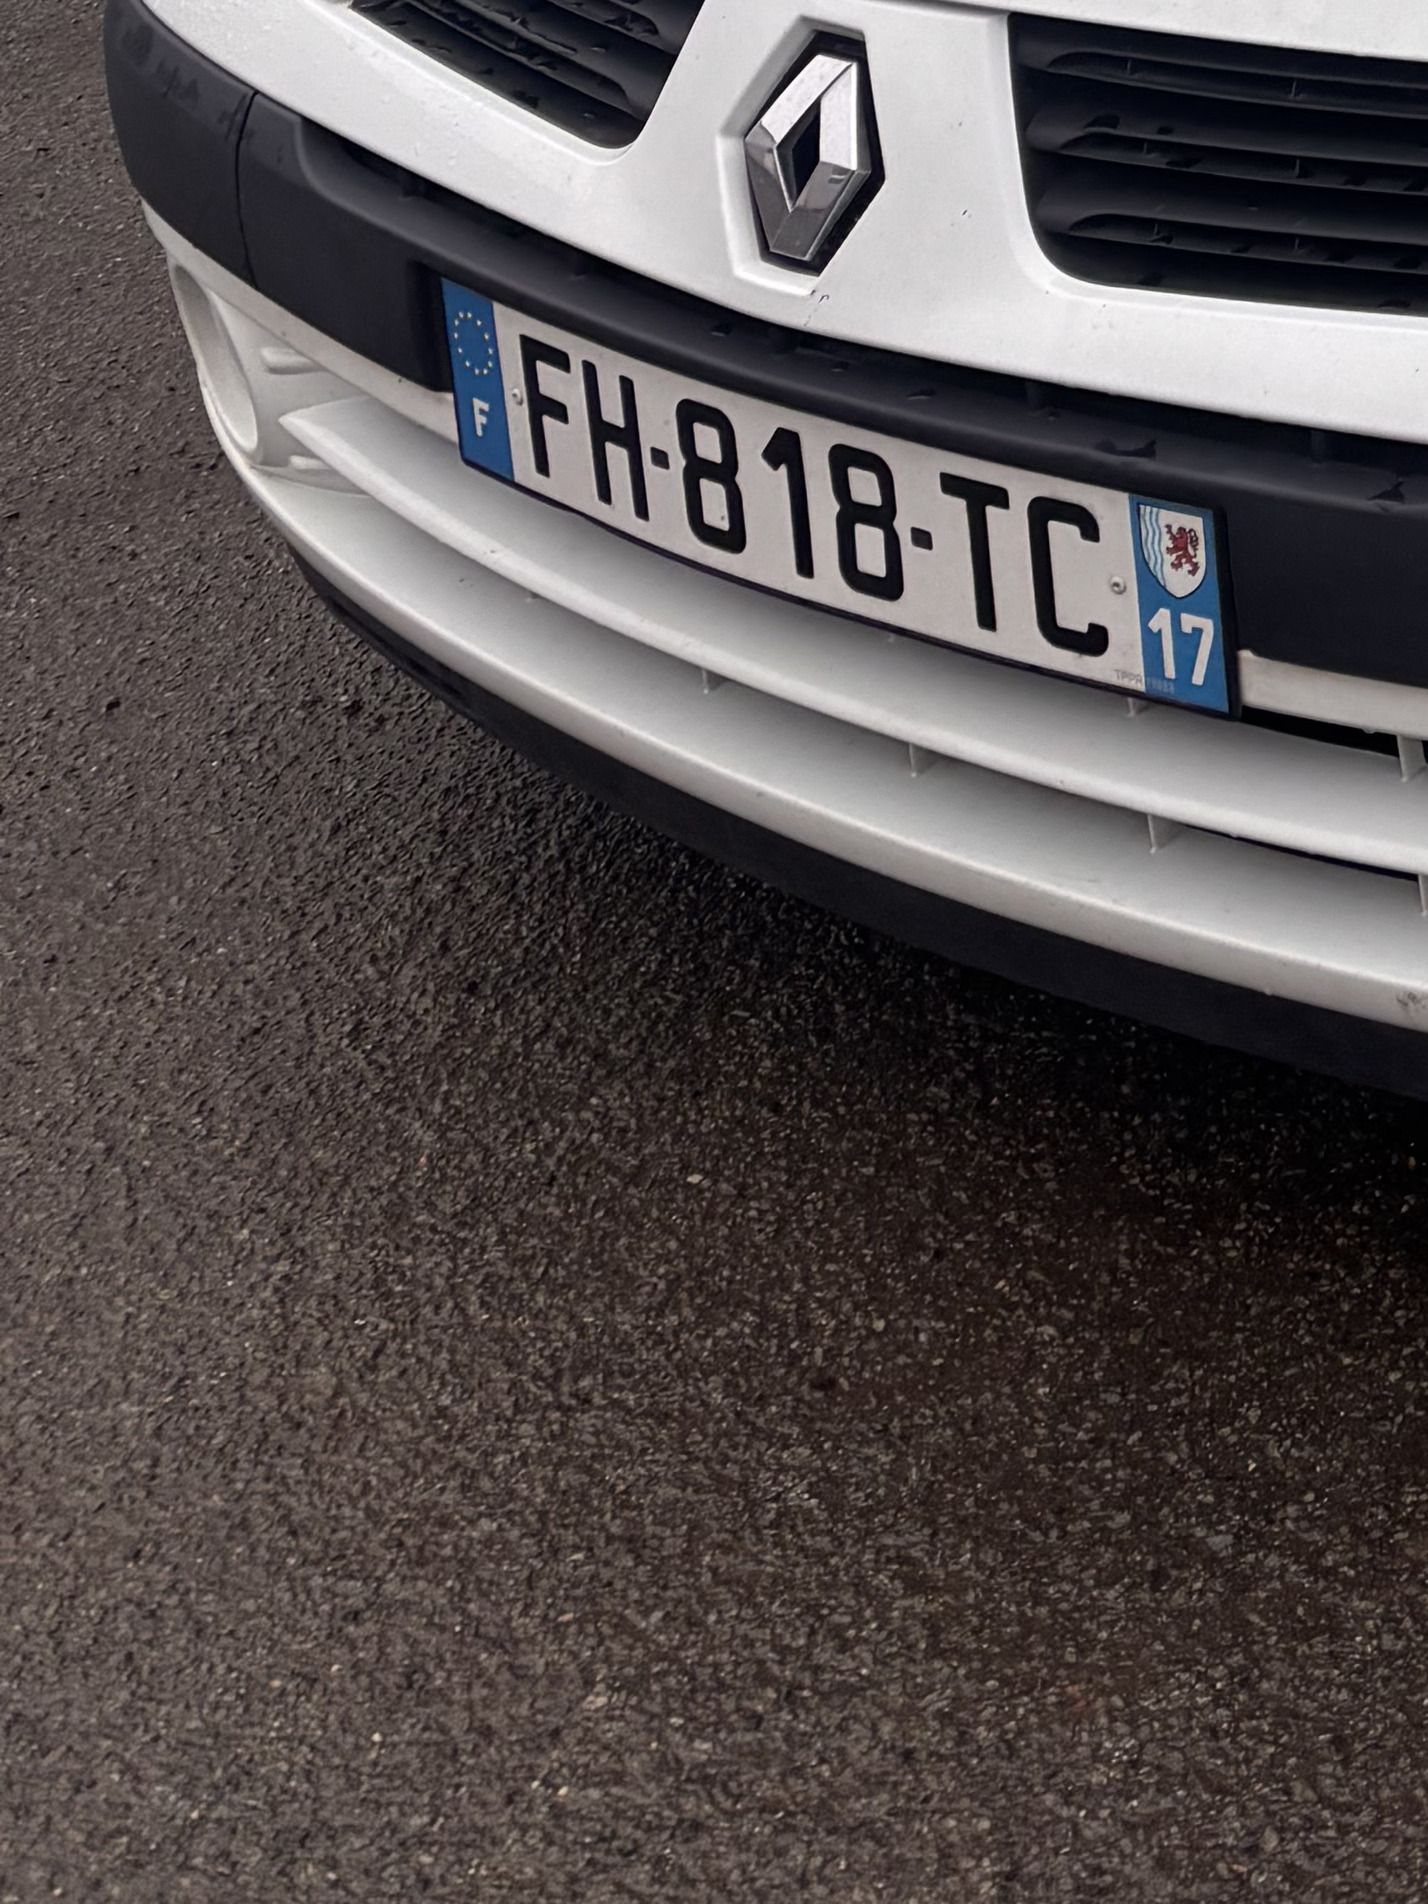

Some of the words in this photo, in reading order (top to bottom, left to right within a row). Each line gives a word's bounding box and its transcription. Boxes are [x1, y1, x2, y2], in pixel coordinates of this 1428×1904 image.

[472, 396, 490, 438] F
[518, 333, 1109, 658] FH-818-TC
[1147, 605, 1215, 687] 17
